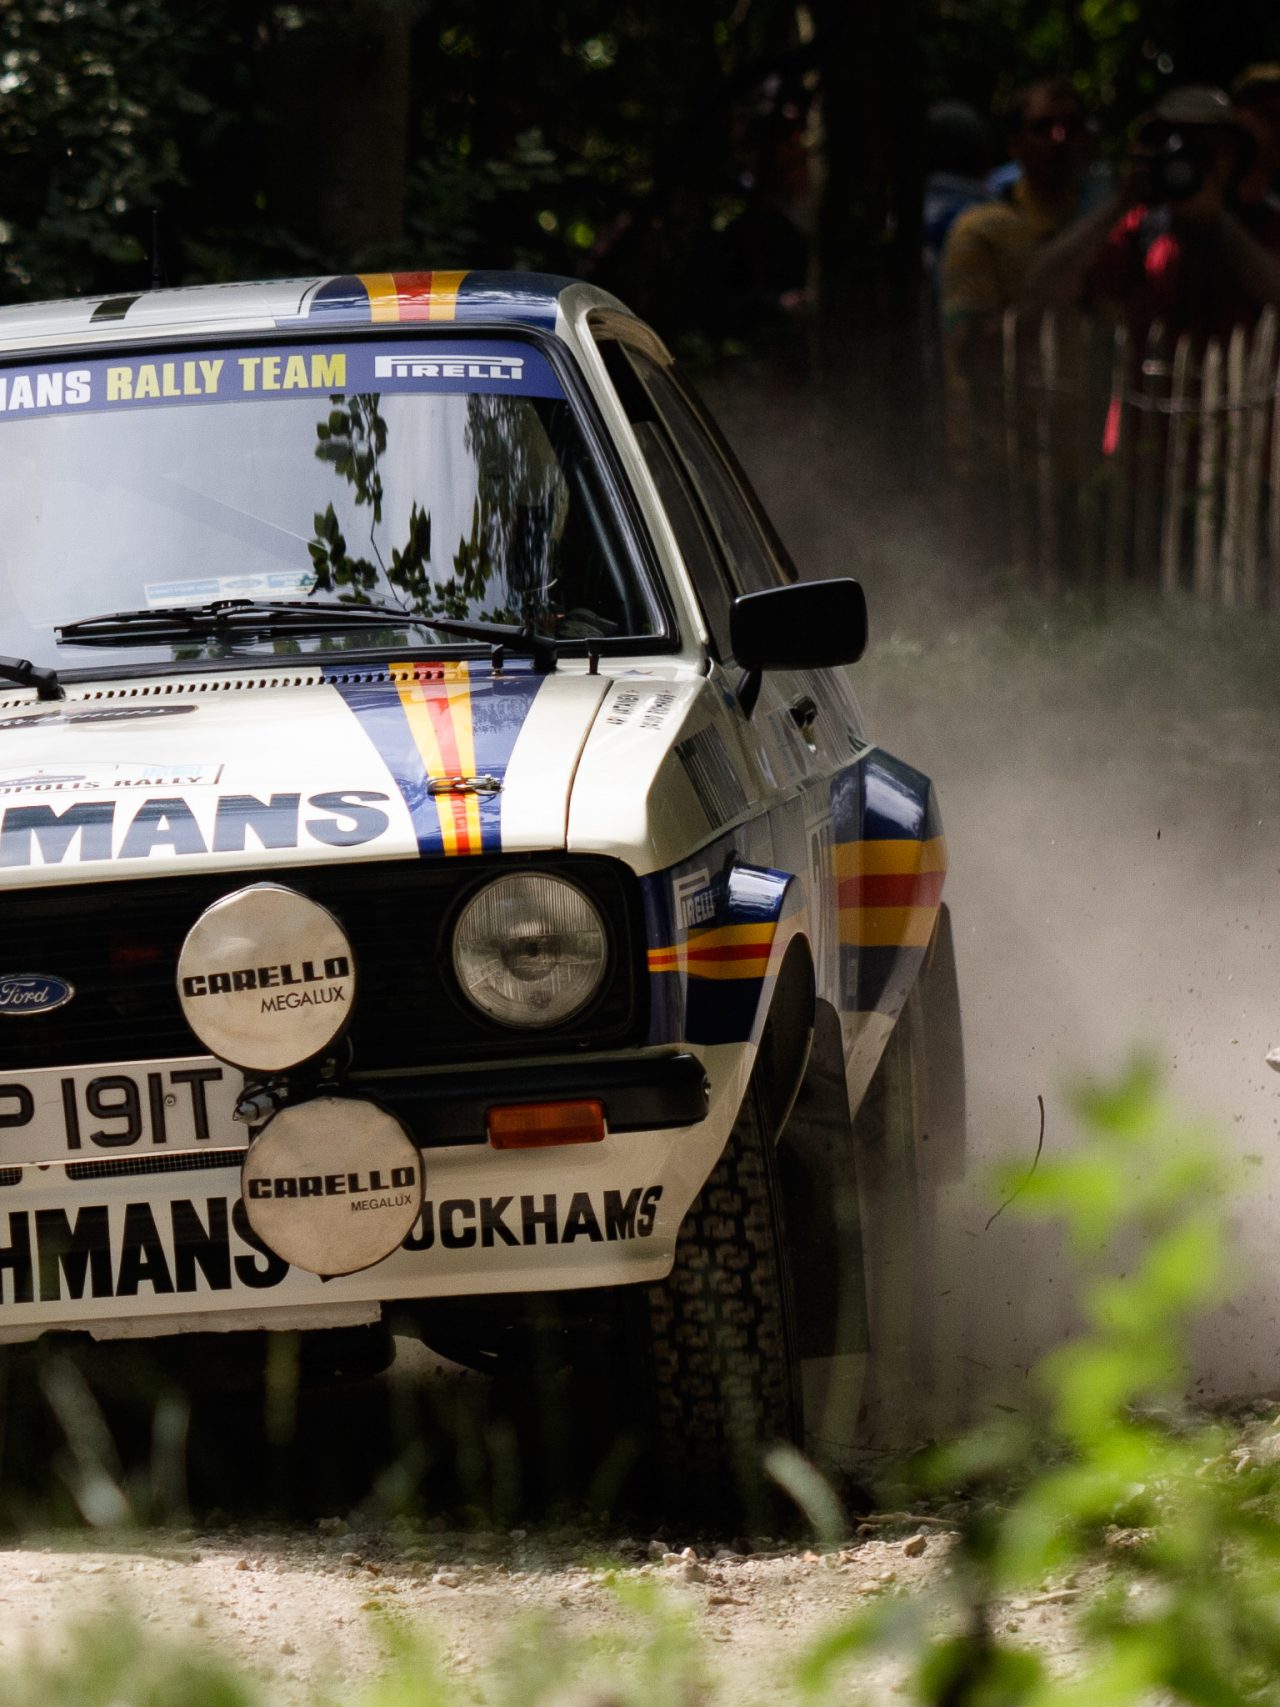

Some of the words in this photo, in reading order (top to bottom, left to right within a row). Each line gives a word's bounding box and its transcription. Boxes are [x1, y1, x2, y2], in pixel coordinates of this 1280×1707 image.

[106, 360, 224, 401] RALLY
[237, 353, 346, 391] TEAM
[374, 355, 524, 380] PIRELLI
[114, 776, 203, 787] RALLY
[182, 956, 350, 998] CARELLO
[260, 986, 345, 1013] MEGALUX
[61, 1067, 224, 1150] 191T
[248, 1166, 416, 1199] CARELLO
[351, 1194, 413, 1212] MEGALUX
[401, 1184, 663, 1251] UCKHAMS
